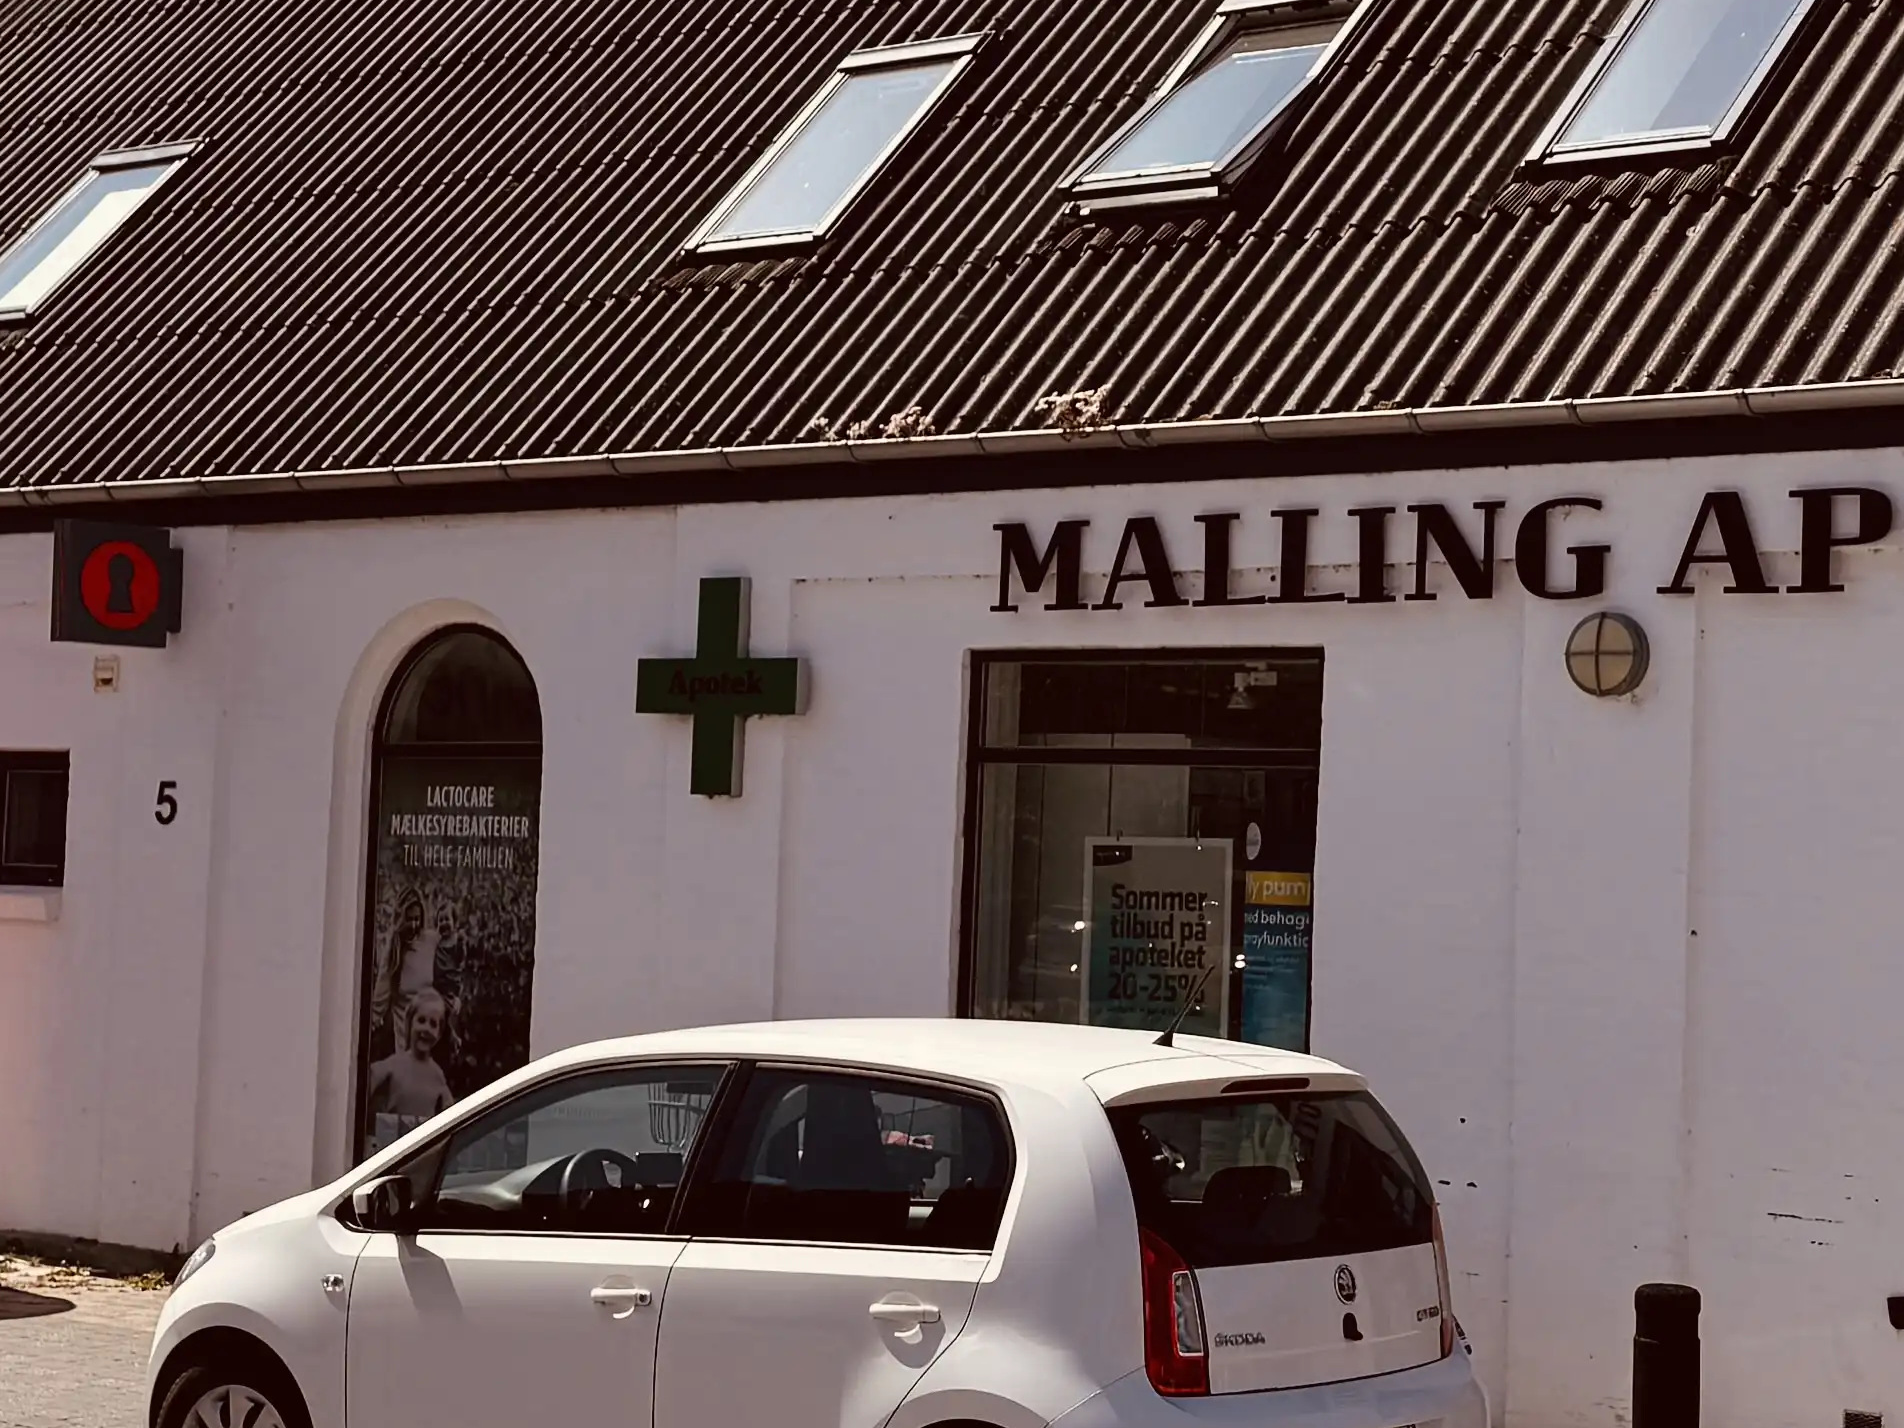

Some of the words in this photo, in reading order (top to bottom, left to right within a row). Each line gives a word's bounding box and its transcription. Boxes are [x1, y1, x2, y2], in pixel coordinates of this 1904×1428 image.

[989, 495, 1612, 613] MALLING
[667, 665, 764, 703] Apotek
[154, 780, 178, 825] 5
[426, 785, 495, 808] LACTOCARE
[390, 814, 530, 838] MÆLKESYREBAKTERIER
[404, 844, 418, 866] TIL
[424, 844, 453, 868] HELE
[456, 845, 515, 870] FAMILIEN
[1110, 883, 1208, 912] Sommer
[1110, 912, 1174, 940] tilbud
[1180, 912, 1207, 947] på
[1108, 941, 1206, 972] apoteket
[1107, 973, 1206, 1004] 20-25%
